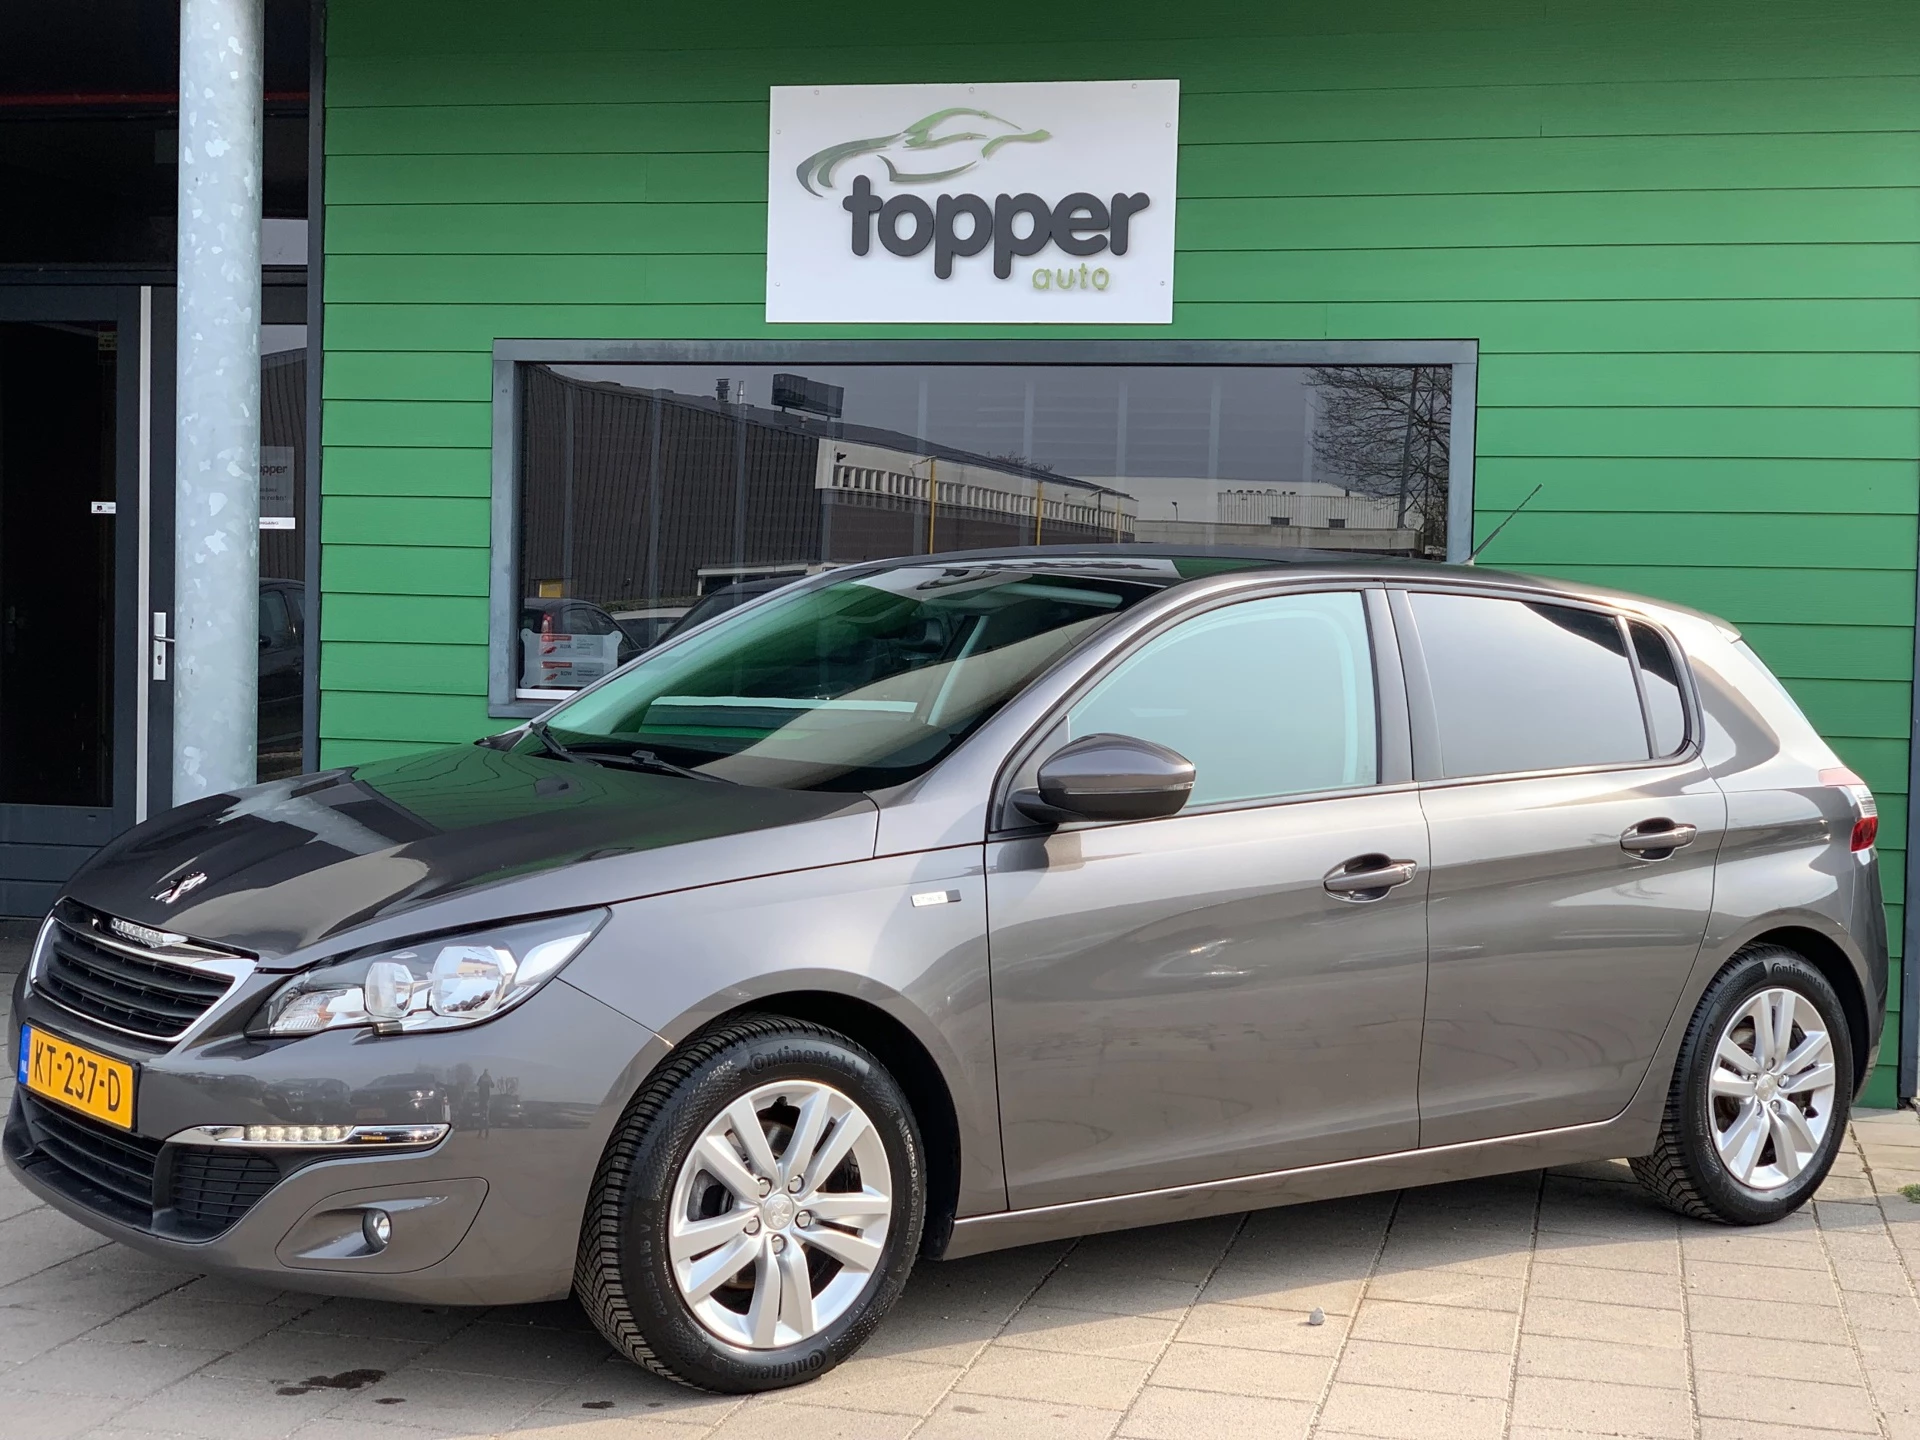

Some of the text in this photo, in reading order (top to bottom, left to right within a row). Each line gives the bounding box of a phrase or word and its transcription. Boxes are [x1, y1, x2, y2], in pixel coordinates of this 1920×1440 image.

[842, 174, 1151, 279] topper
[1031, 262, 1111, 291] auto
[34, 1038, 121, 1113] KT-237-D
[747, 1044, 849, 1077] Continental
